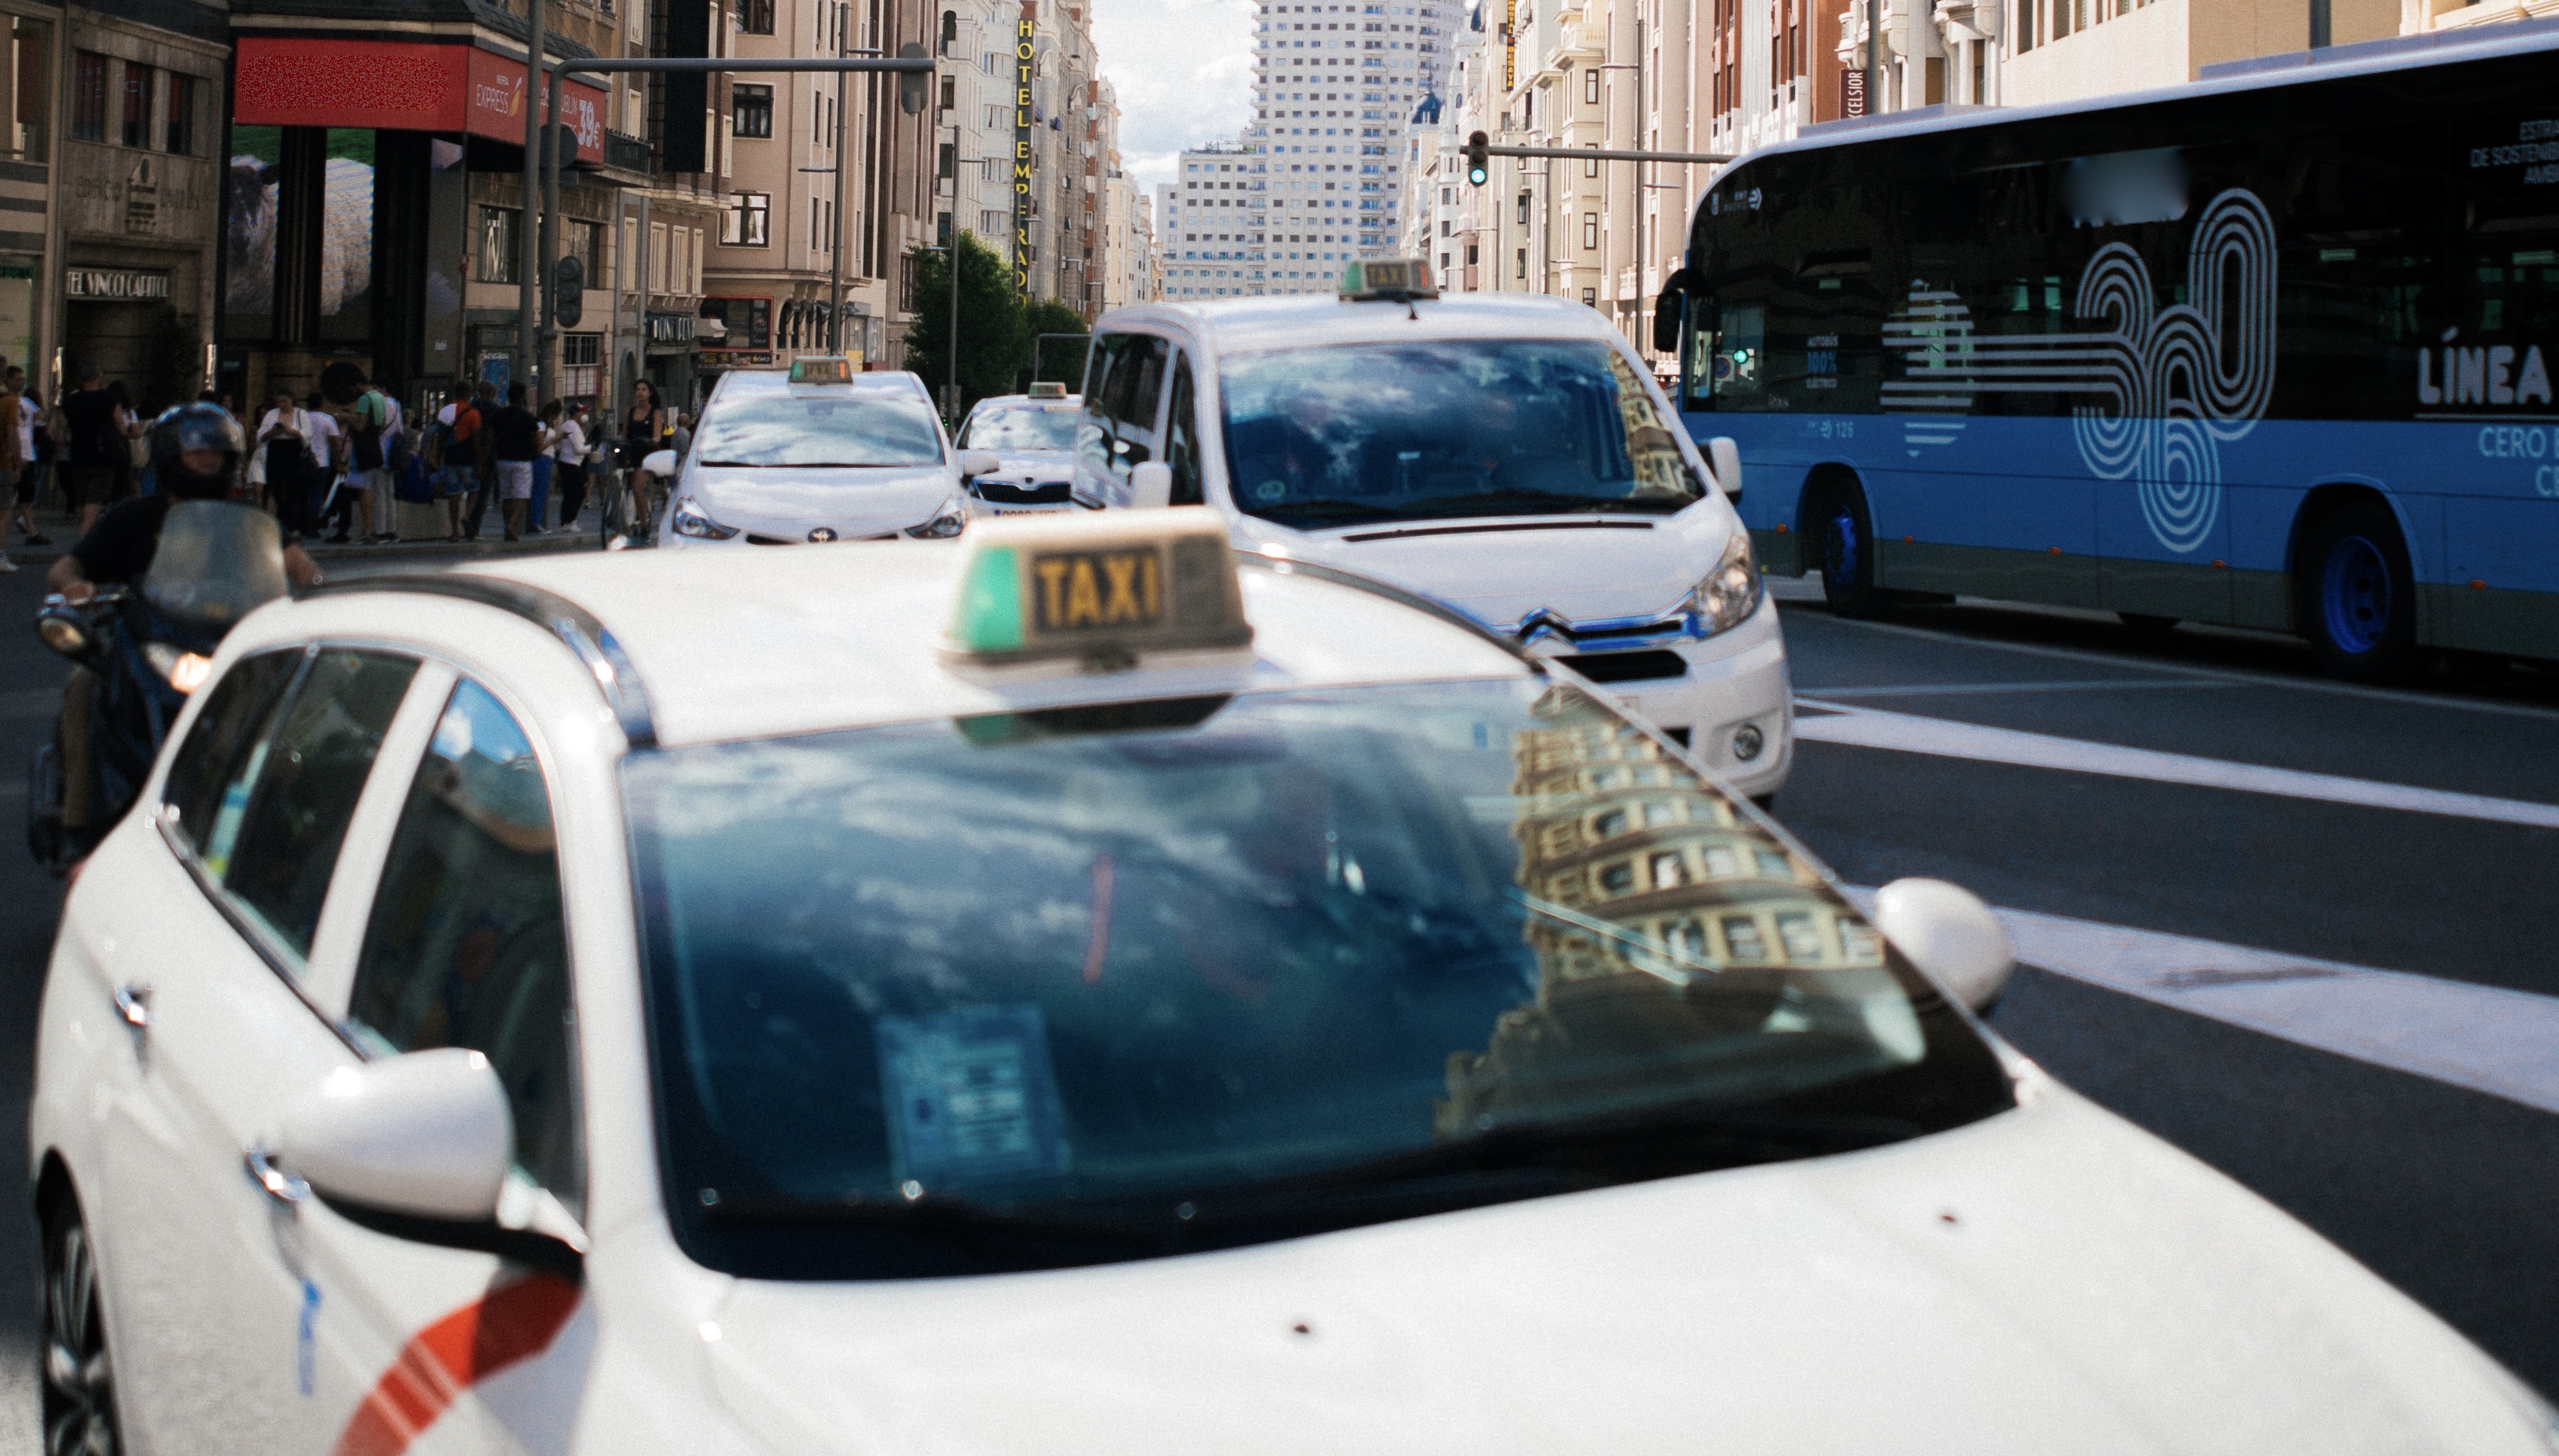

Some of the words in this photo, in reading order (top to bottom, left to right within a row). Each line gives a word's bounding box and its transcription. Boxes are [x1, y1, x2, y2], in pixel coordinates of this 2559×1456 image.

[1016, 20, 1034, 128] HOTEL
[476, 84, 509, 115] EXPRESS
[1848, 71, 1864, 119] XCELSIOR
[2470, 147, 2490, 168] DE
[127, 274, 169, 298] CAPITOL
[1369, 265, 1406, 285] TAXI
[1807, 351, 1838, 374] 100%
[2418, 326, 2553, 405] LÍNEA
[1836, 421, 1855, 438] 126
[2479, 426, 2547, 457] CERO
[1038, 555, 1161, 625] TAXI
